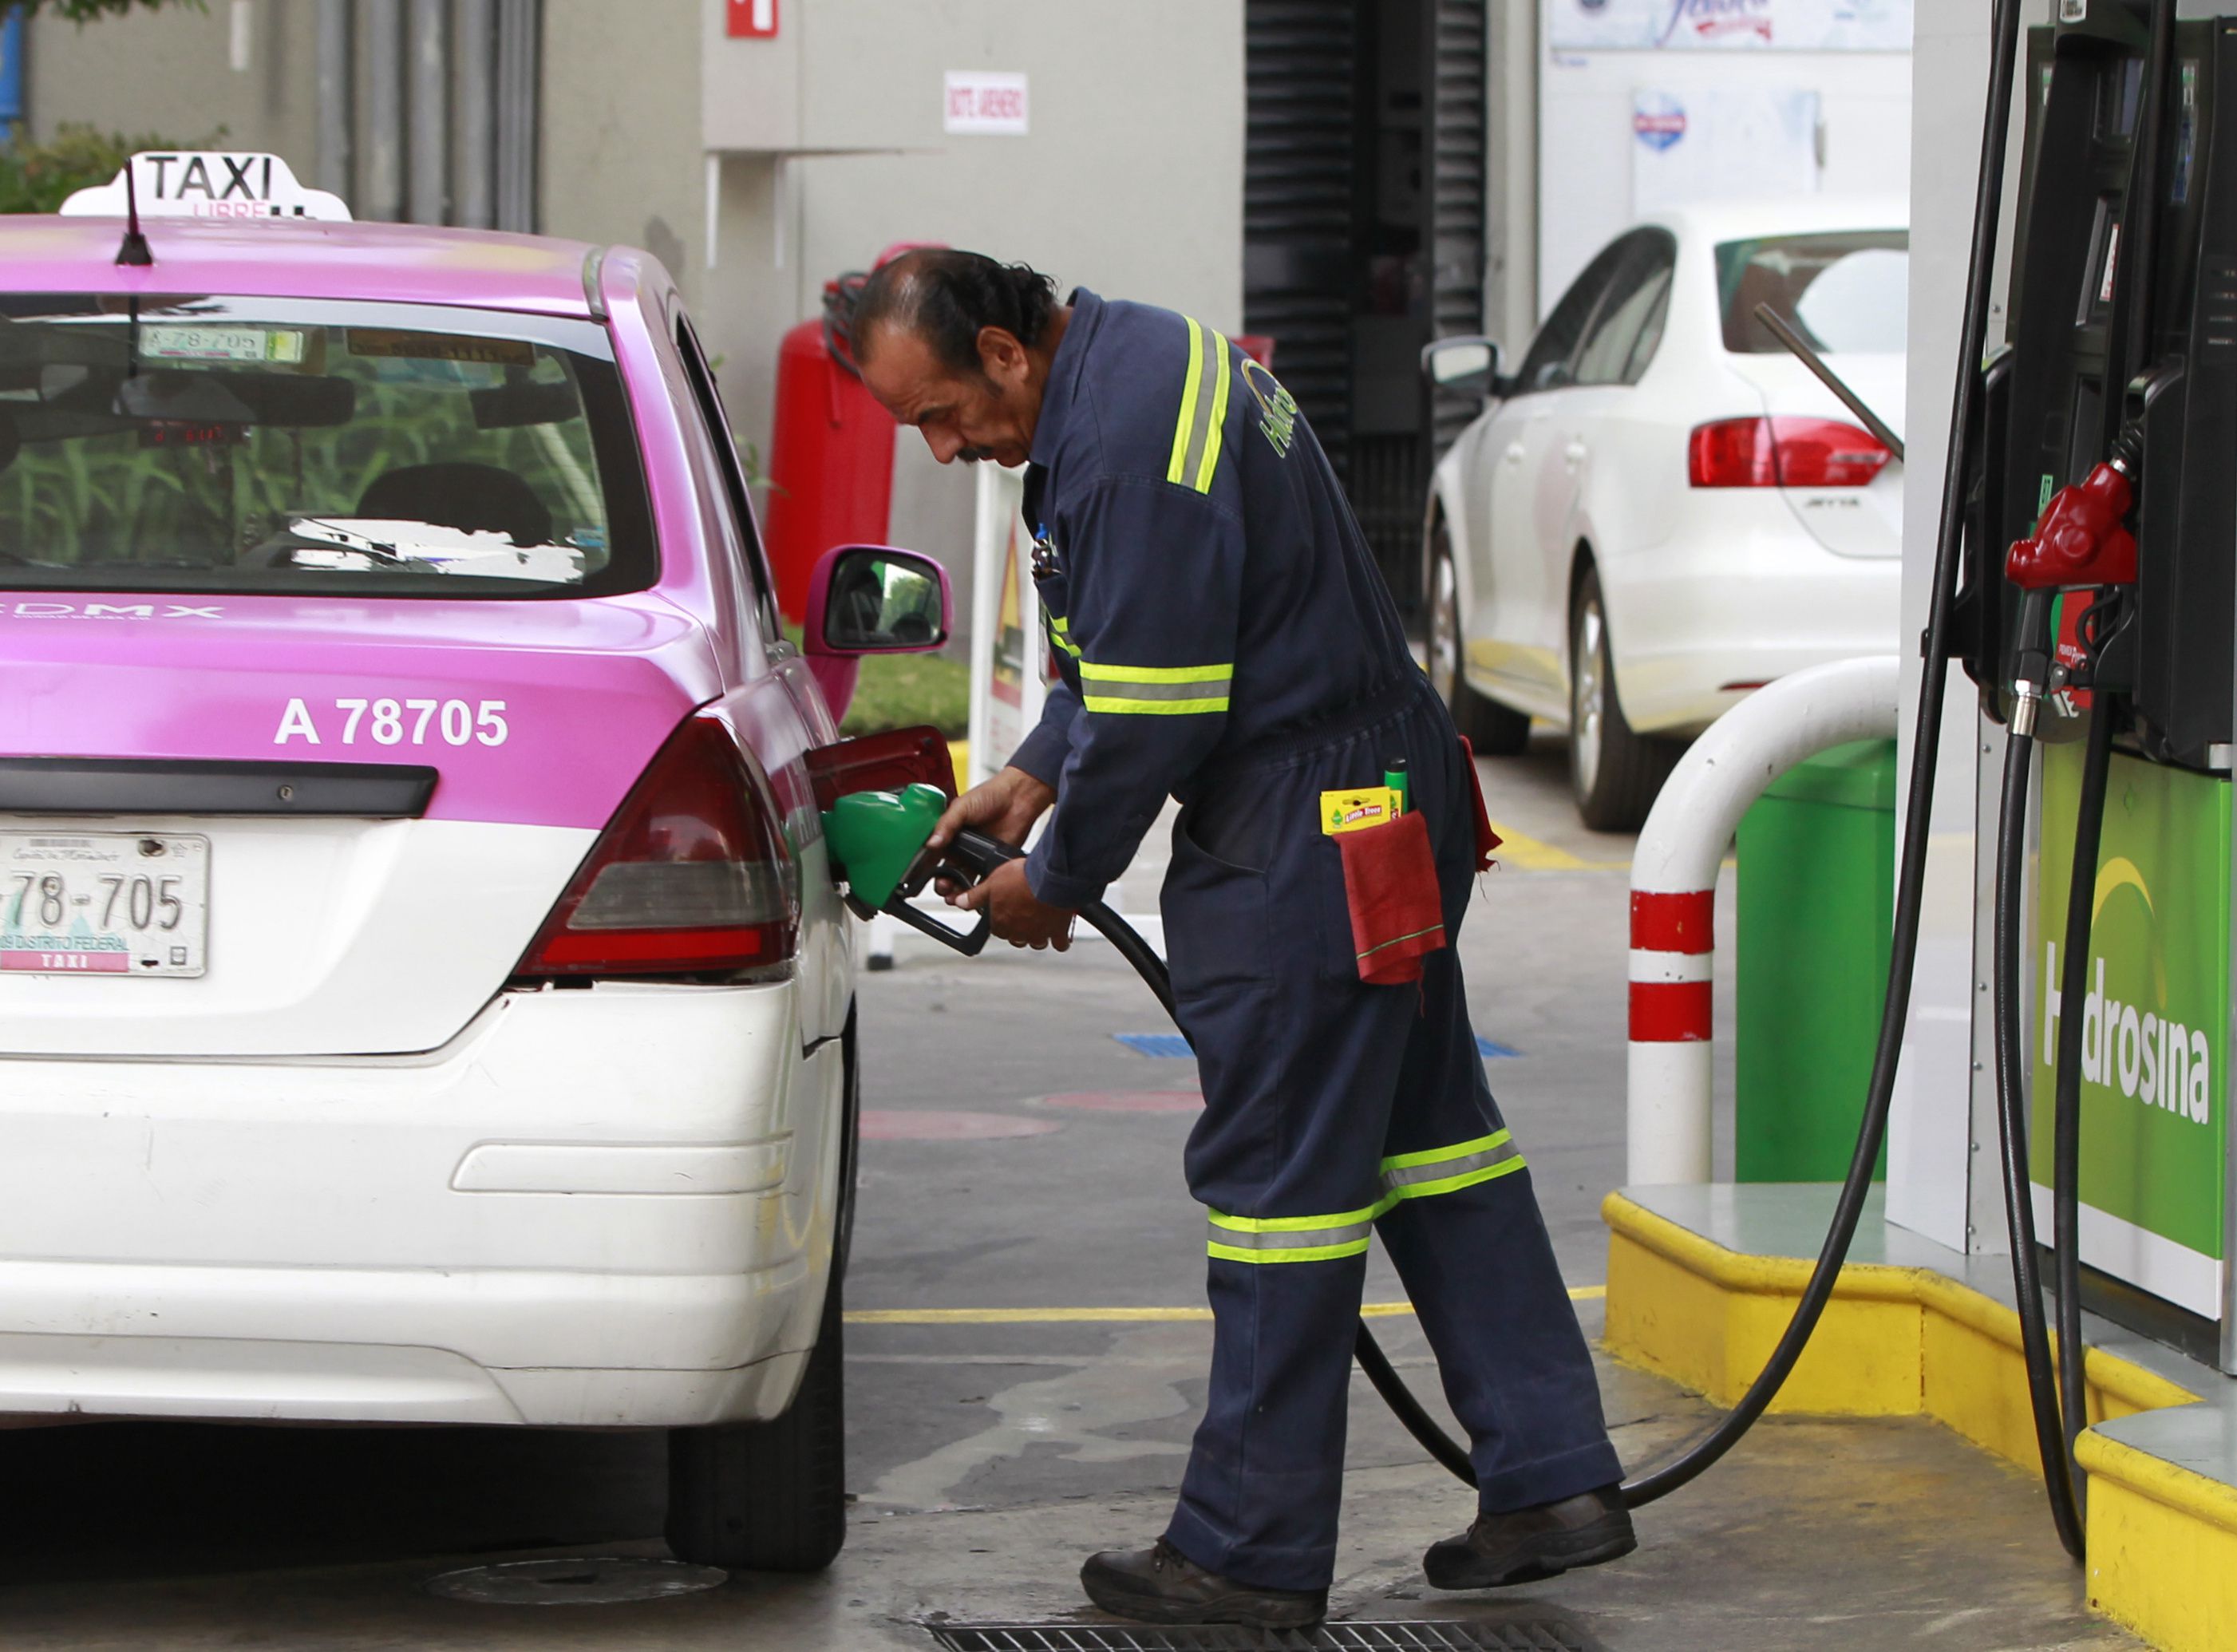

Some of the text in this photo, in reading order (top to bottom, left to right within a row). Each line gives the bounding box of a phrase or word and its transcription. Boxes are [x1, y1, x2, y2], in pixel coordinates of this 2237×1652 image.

[145, 156, 271, 200] TAXI
[0, 603, 225, 619] DMX
[273, 698, 509, 746] A 78705
[1346, 810, 1363, 822] Little
[1365, 806, 1381, 815] Trees
[73, 935, 129, 951] FEDERAL
[41, 954, 88, 969] TAXI
[2044, 941, 2208, 1125] Hdrosina
